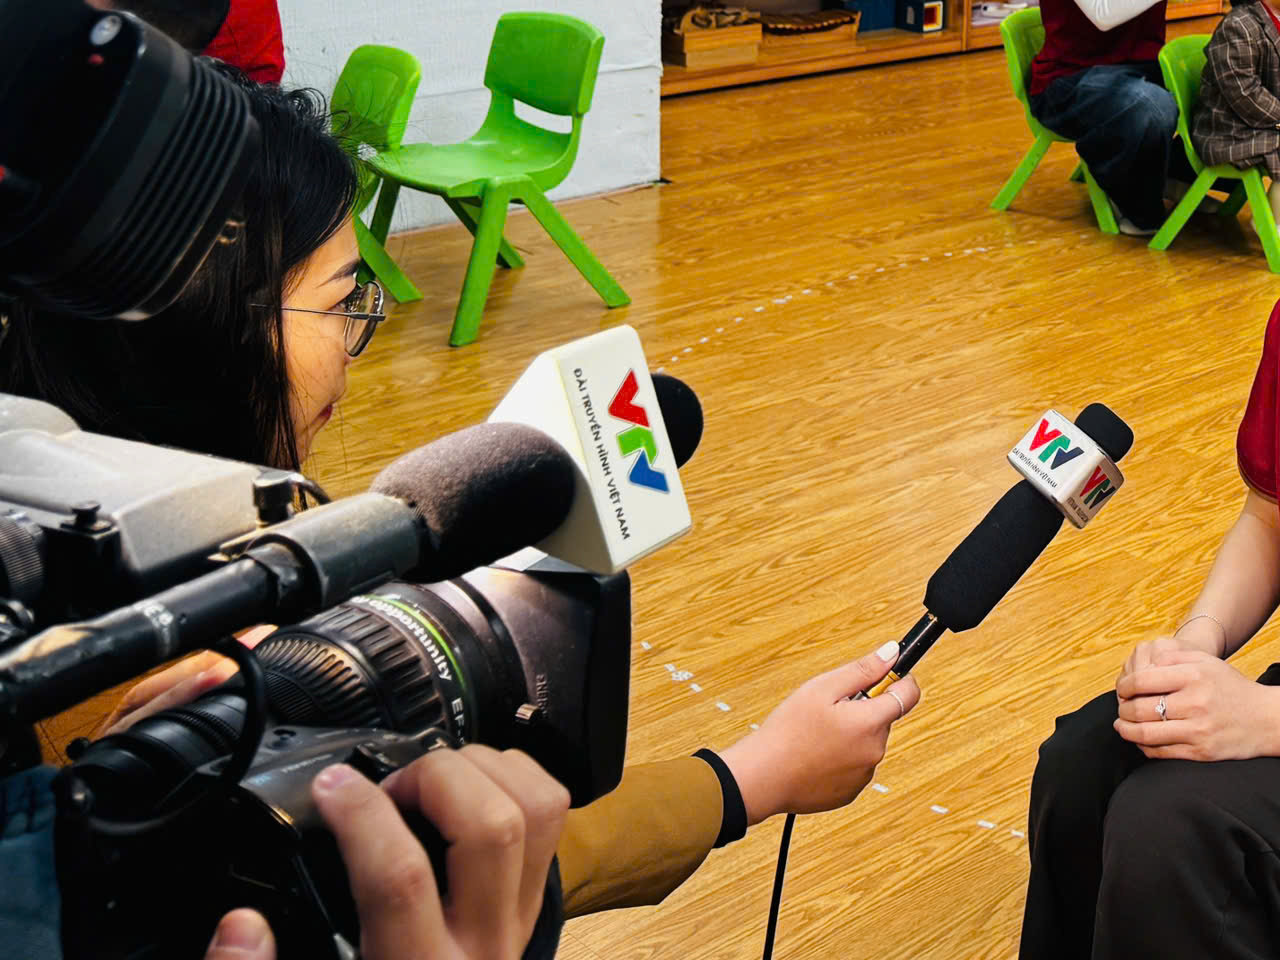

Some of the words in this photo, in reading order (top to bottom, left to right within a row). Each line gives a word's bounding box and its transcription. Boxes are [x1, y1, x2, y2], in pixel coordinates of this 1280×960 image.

[574, 368, 588, 392] ĐÀI
[581, 394, 602, 442] TRUYỀN
[596, 444, 612, 477] HÌNH
[607, 478, 621, 505] VIỆT
[615, 507, 631, 540] NAM
[608, 368, 670, 494] VTV
[1029, 418, 1085, 470] VTV
[1080, 465, 1116, 510] VTV
[368, 600, 452, 681] opportunity
